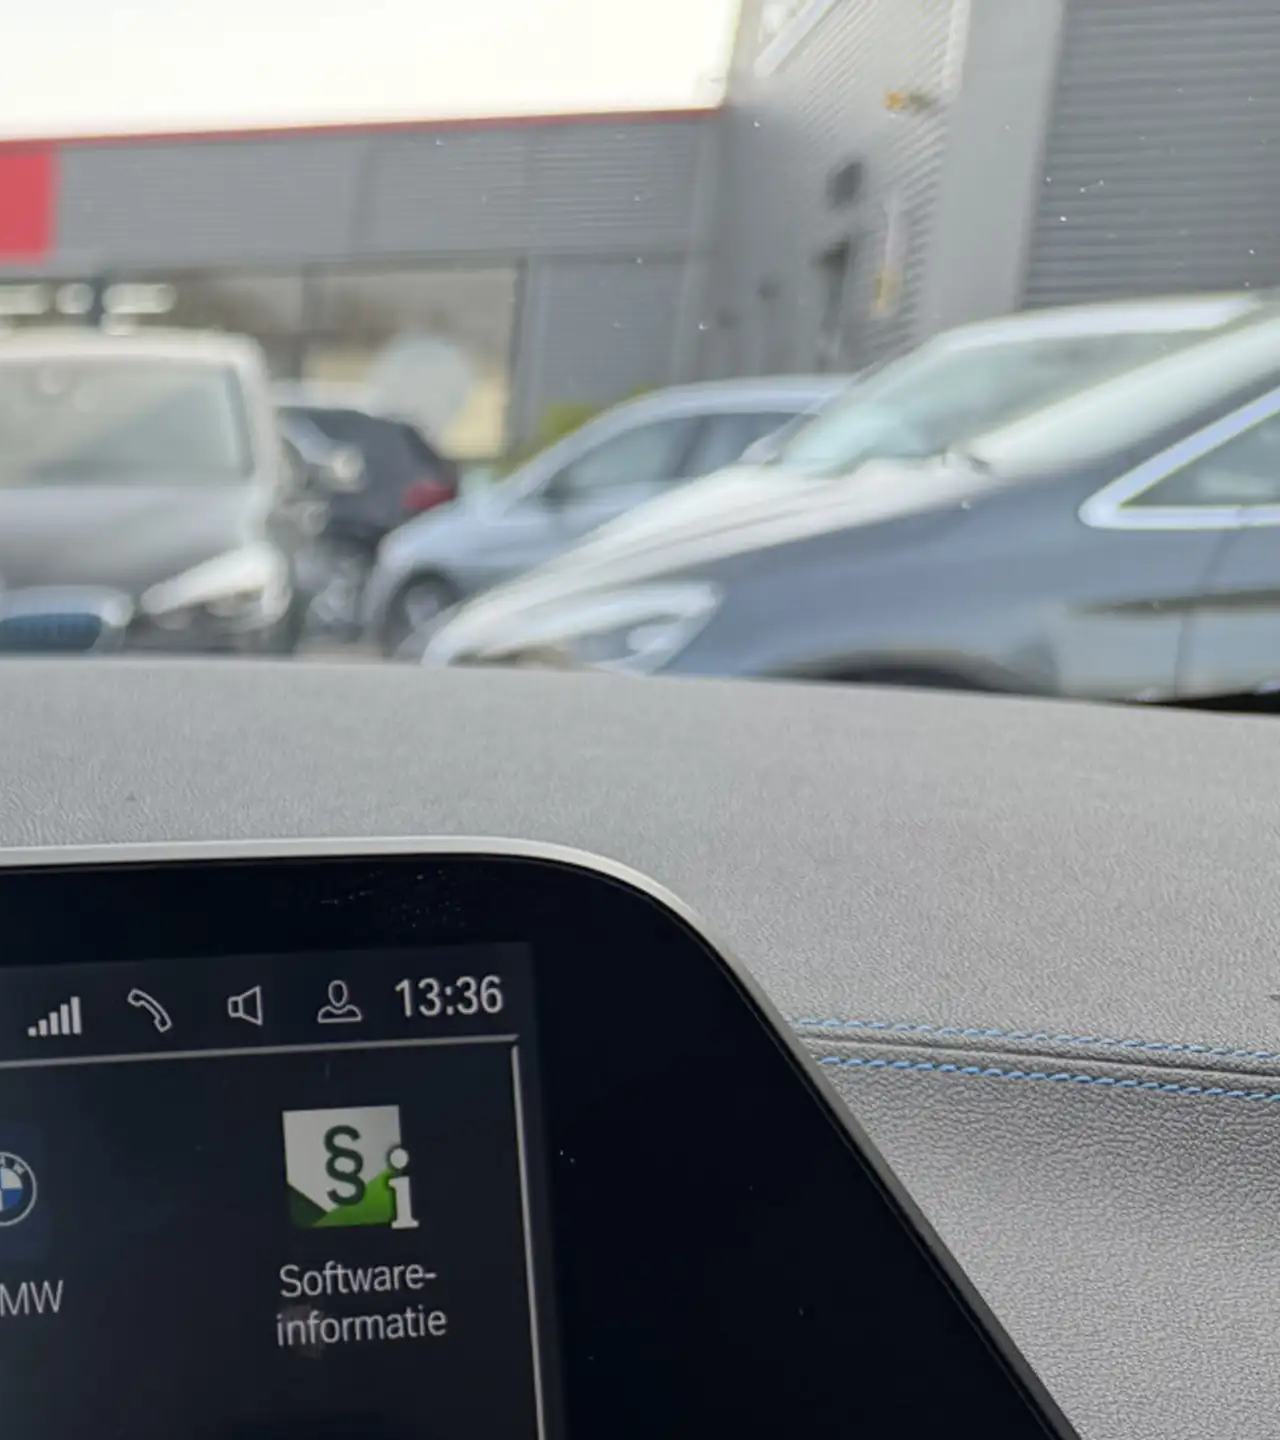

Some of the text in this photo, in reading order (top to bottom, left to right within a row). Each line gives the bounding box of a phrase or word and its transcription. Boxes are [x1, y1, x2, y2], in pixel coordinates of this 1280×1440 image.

[394, 975, 504, 1018] 13:36
[279, 1260, 437, 1298] Software-
[276, 1304, 448, 1347] informatie
